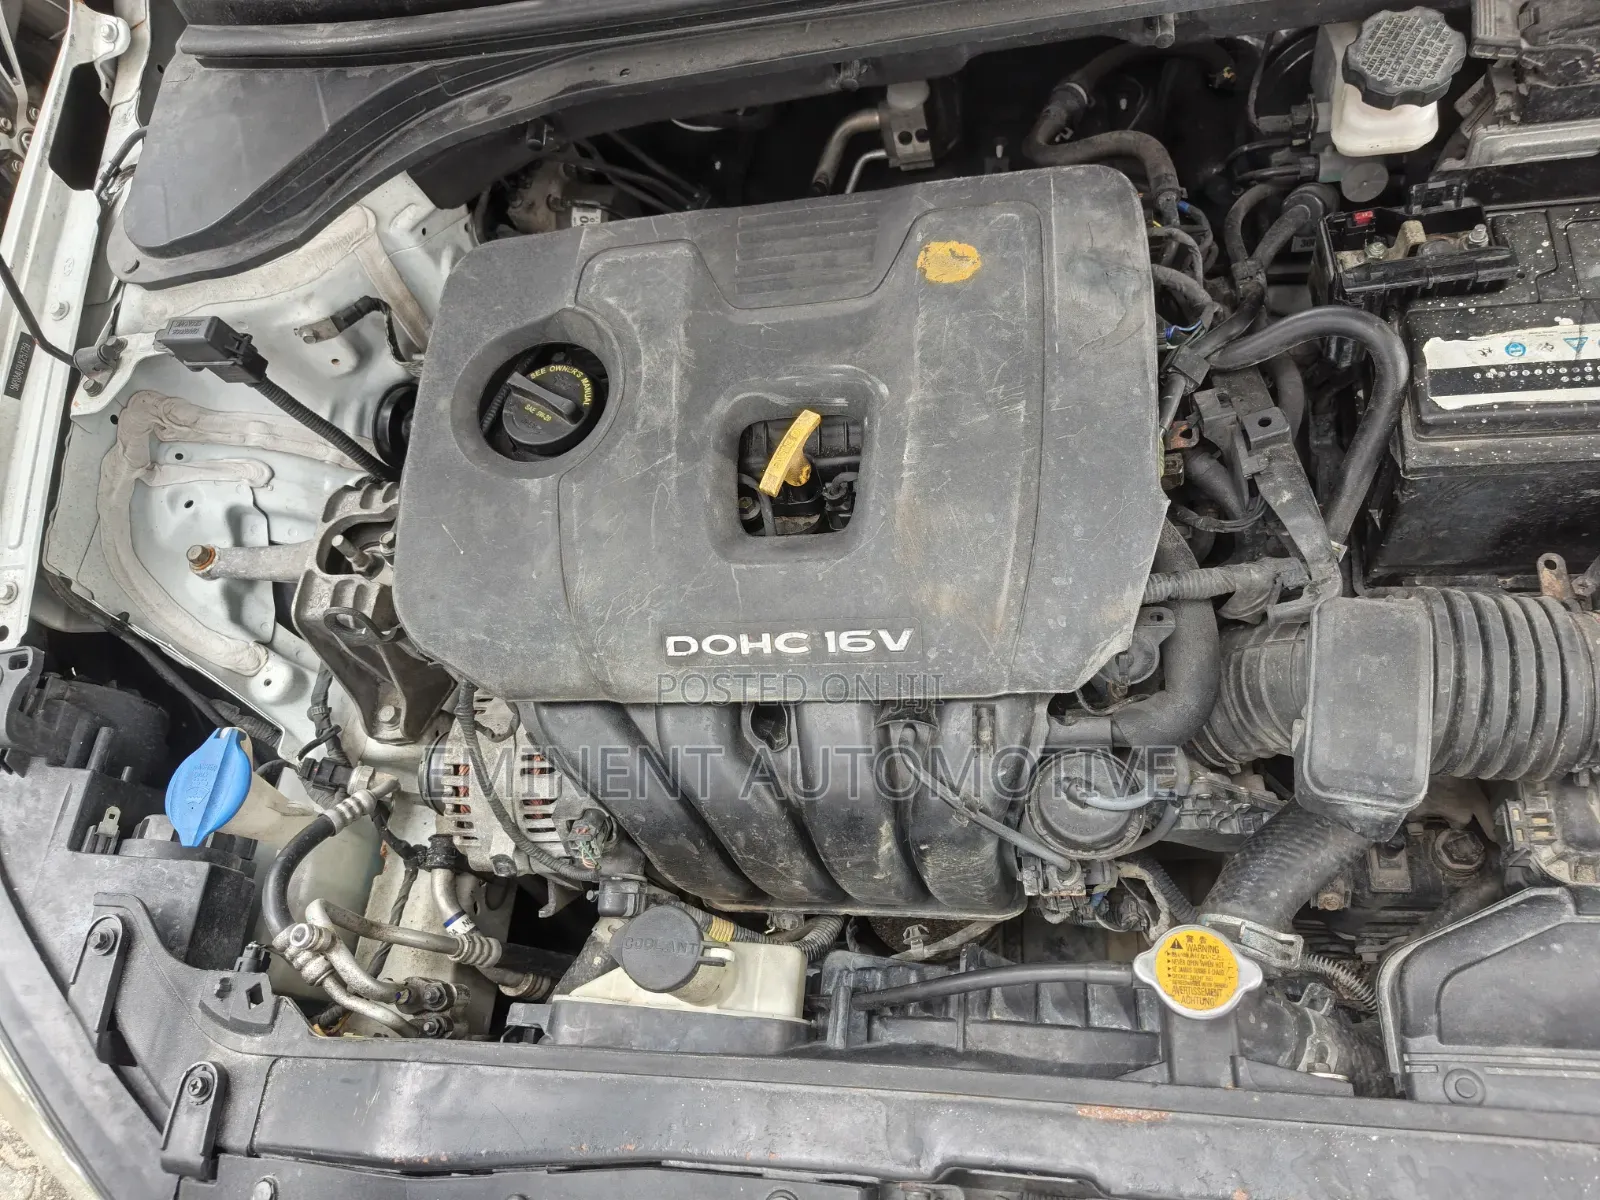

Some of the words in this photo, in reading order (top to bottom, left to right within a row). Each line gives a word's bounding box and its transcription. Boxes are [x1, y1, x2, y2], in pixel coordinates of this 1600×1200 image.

[530, 367, 547, 380] SEE
[549, 364, 584, 378] OWNER'S
[581, 377, 592, 406] MANUAL
[524, 404, 536, 414] SAE
[665, 631, 811, 657] DOHC
[824, 627, 915, 653] 16V
[624, 937, 699, 955] COOLANT
[1186, 943, 1219, 954] WARNING
[1181, 996, 1215, 1006] ACHTUNG
